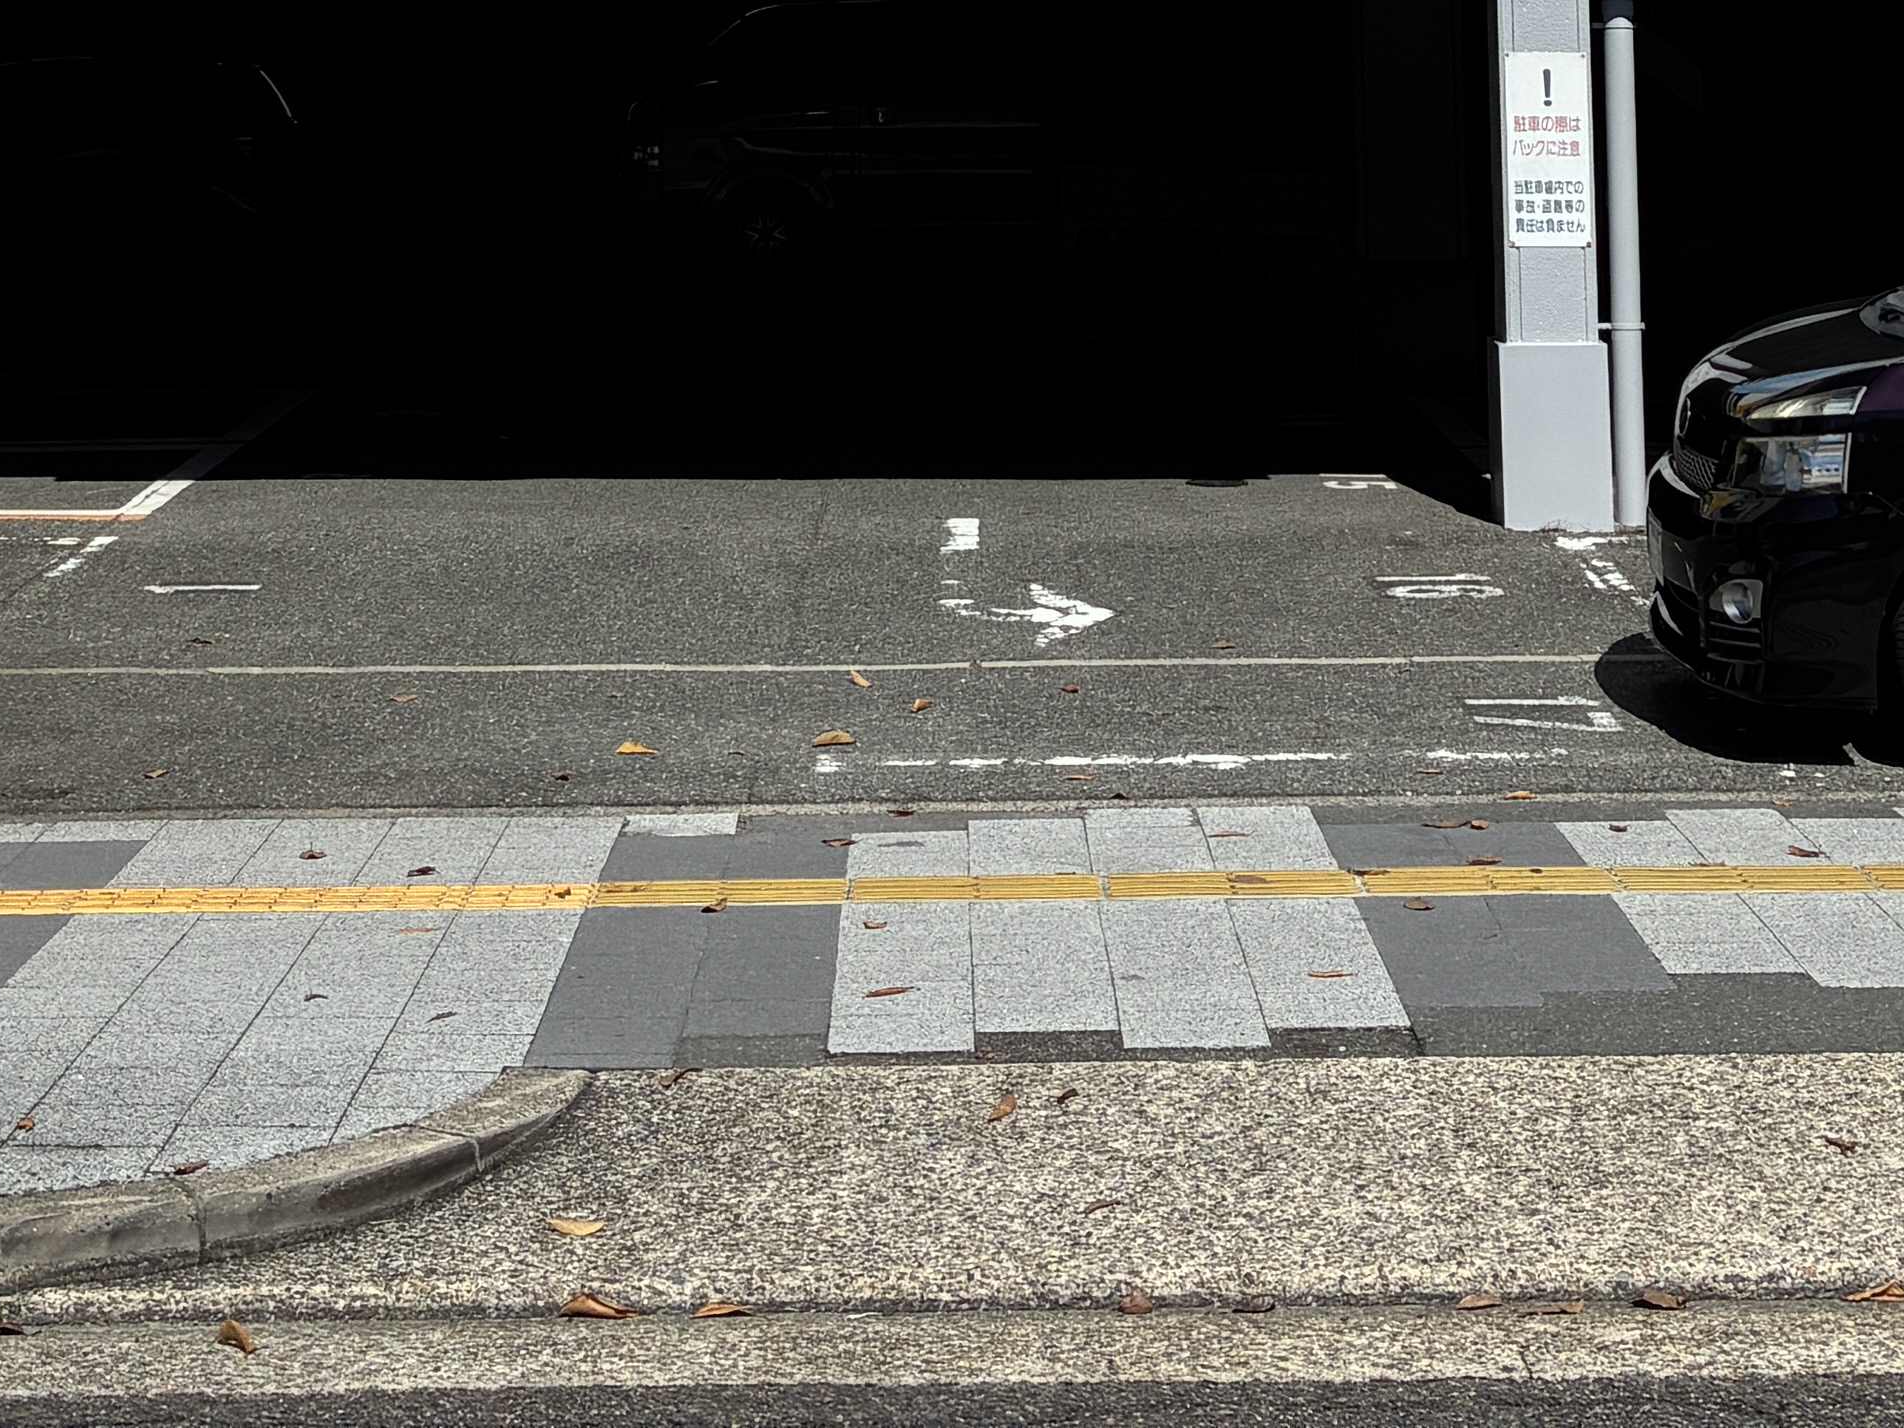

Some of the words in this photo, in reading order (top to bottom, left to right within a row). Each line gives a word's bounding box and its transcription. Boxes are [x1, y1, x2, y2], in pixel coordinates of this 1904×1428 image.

[1513, 115, 1581, 133] 駐車の際は
[1512, 139, 1581, 157] バックに注意
